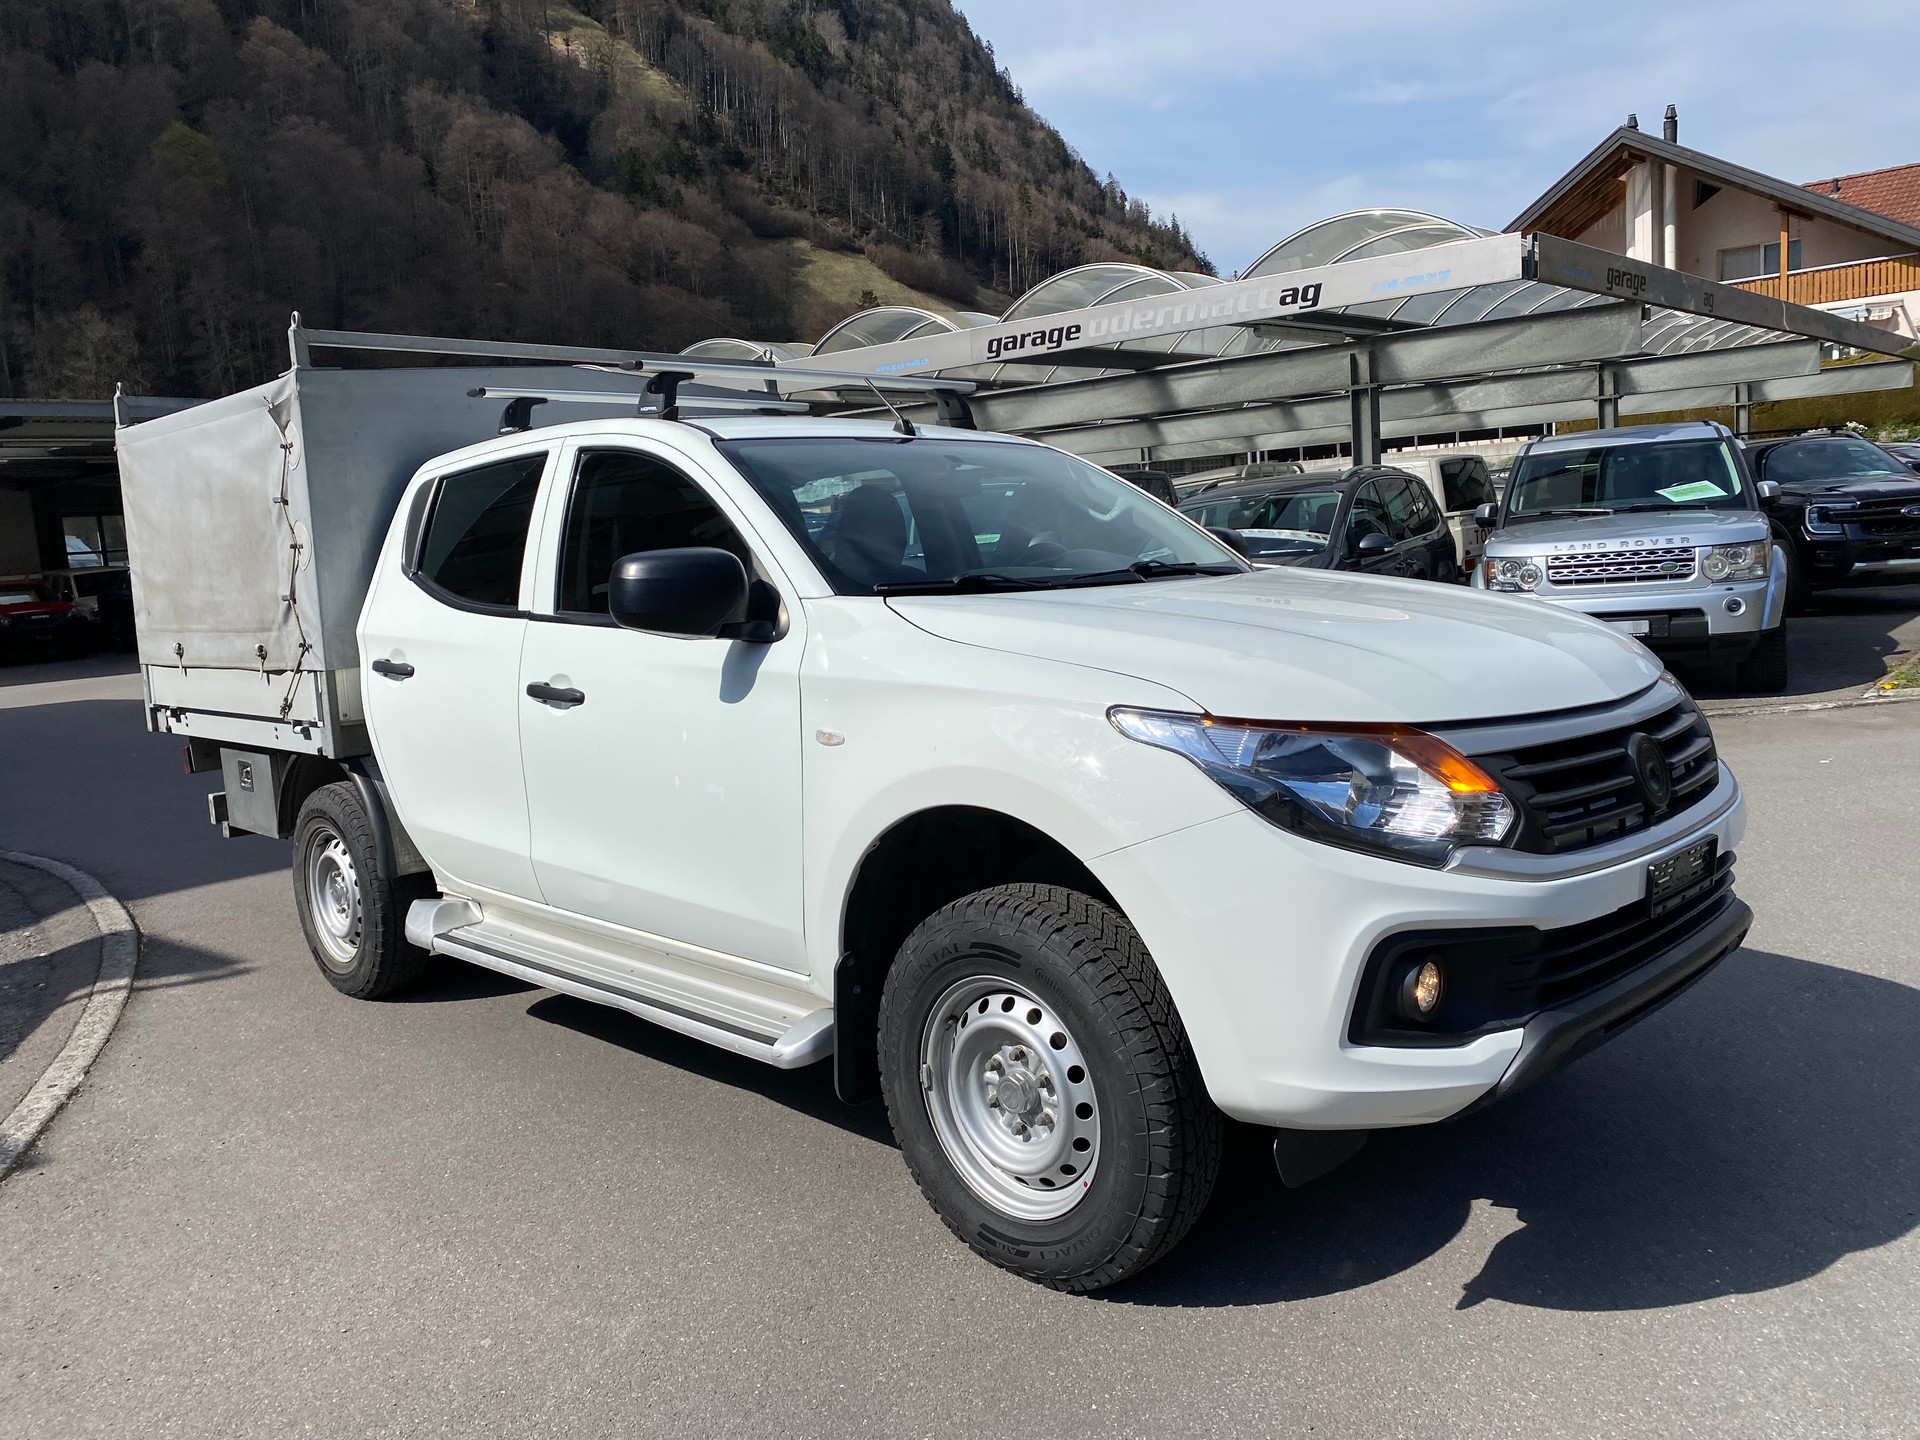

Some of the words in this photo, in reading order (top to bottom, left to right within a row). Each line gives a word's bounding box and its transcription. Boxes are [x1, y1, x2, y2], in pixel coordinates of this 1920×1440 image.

[1606, 267, 1647, 297] garage
[1703, 292, 1715, 312] ag
[987, 323, 1082, 360] garage
[1279, 282, 1323, 310] ag
[1553, 542, 1608, 552] LAND
[1619, 536, 1691, 549] ROVER
